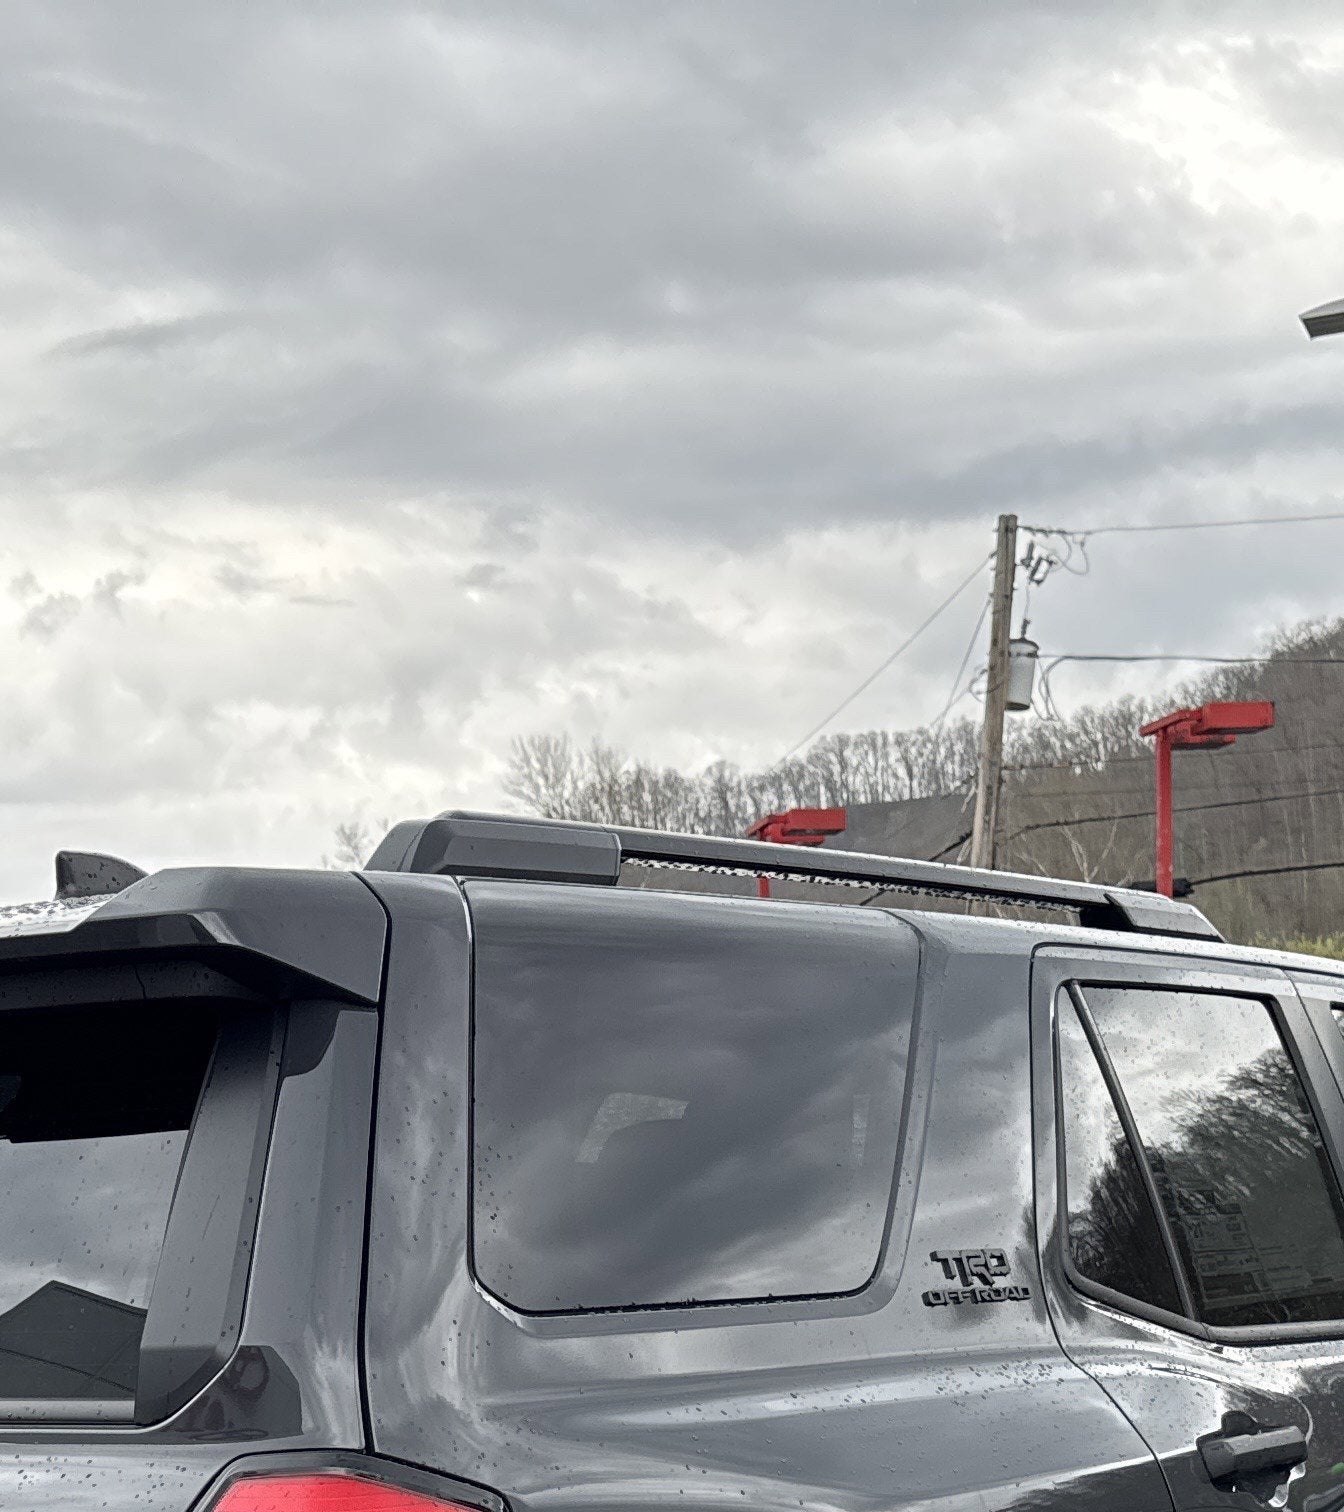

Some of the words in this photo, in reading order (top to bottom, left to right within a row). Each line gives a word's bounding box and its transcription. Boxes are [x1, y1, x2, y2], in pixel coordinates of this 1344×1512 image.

[929, 1248, 1011, 1287] TRD
[921, 1287, 973, 1307] OFF
[973, 1286, 1033, 1304] ROAD
